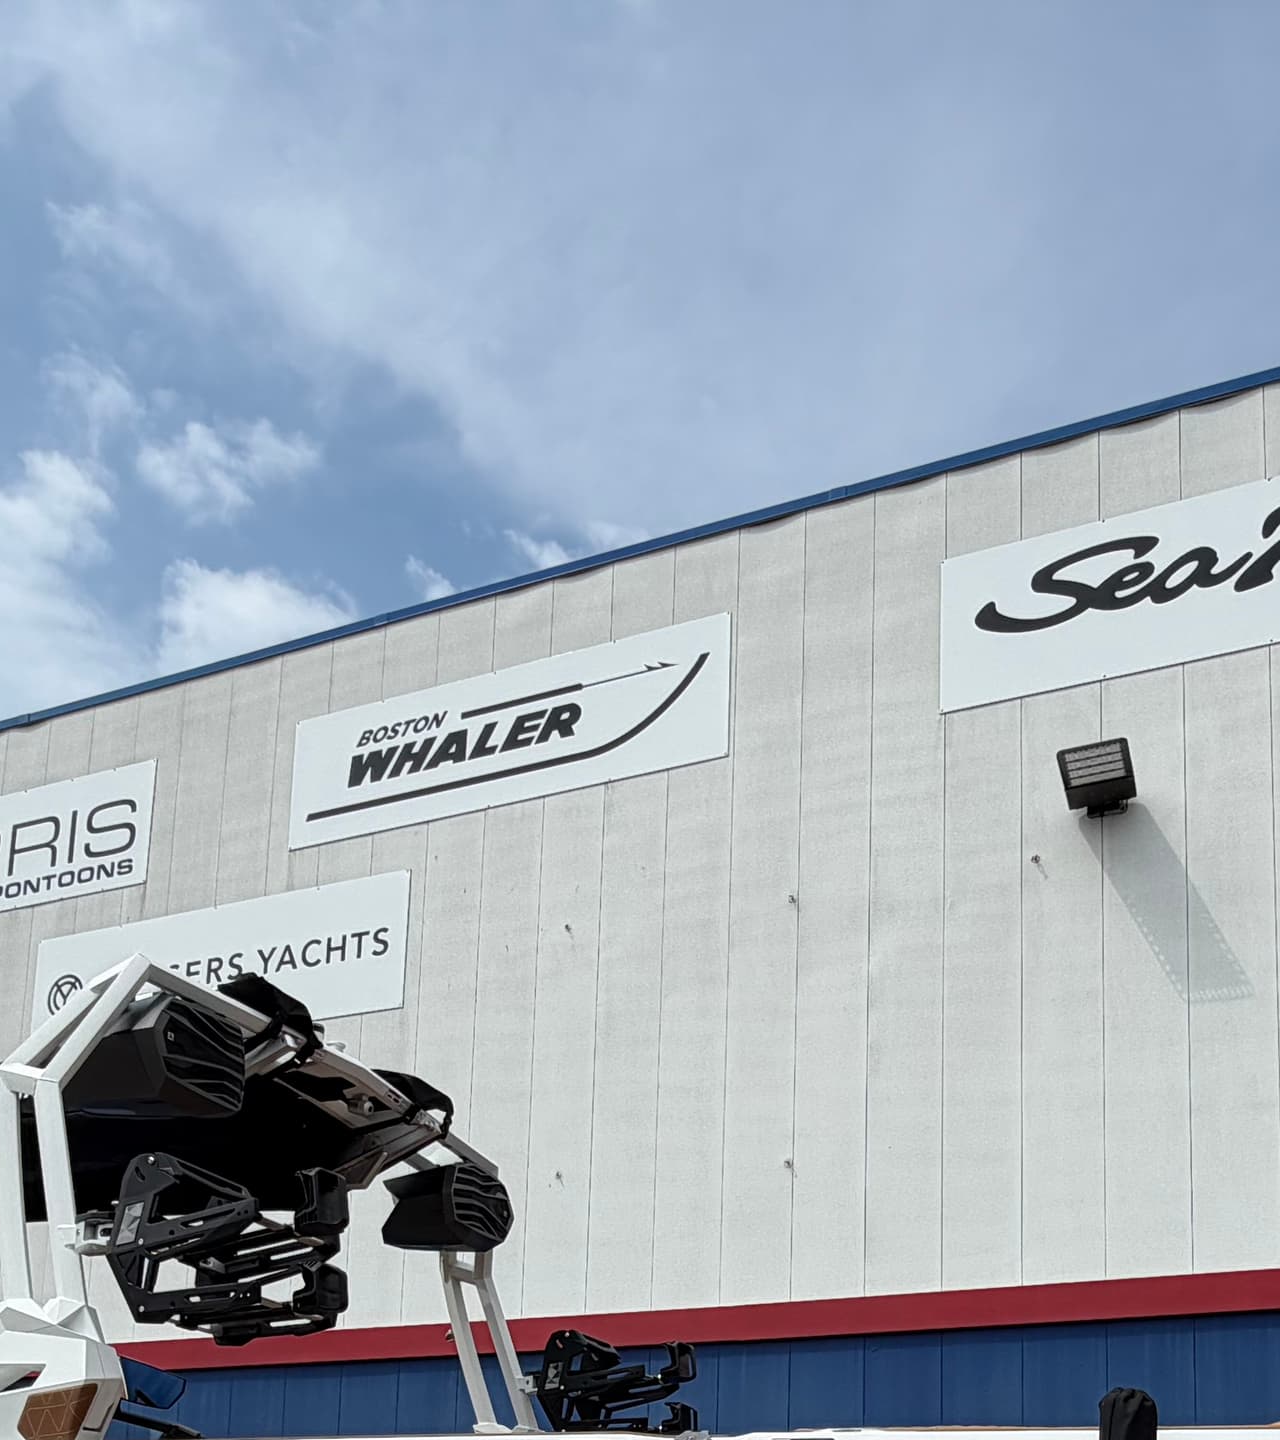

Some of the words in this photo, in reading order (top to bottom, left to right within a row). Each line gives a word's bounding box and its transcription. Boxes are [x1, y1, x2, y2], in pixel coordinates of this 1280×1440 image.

[974, 535, 1253, 633] Sea
[347, 702, 582, 788] WHALER
[356, 710, 448, 748] BOSTON
[256, 926, 391, 975] YACHTS
